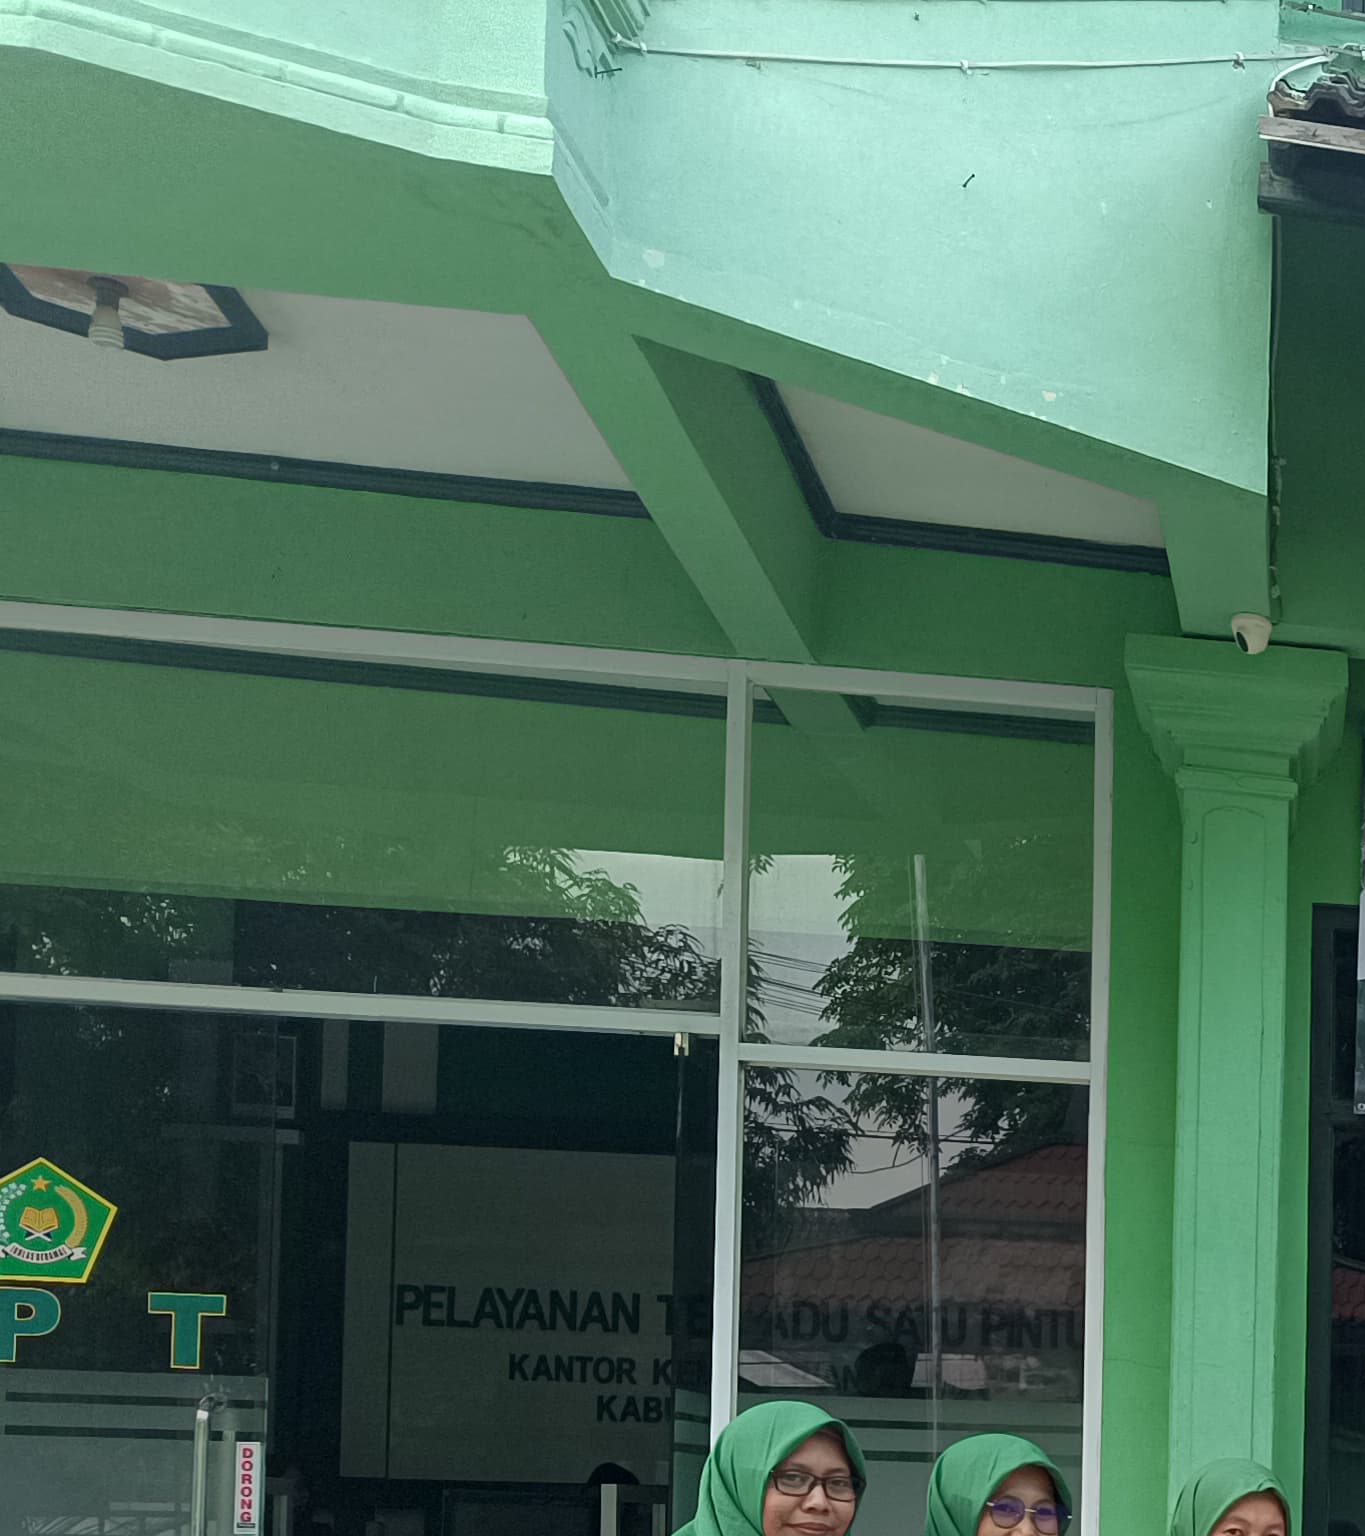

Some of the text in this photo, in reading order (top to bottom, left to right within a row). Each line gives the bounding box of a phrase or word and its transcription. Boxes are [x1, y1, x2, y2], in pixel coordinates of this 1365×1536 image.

[395, 1283, 641, 1335] PELAYANAN
[508, 1353, 637, 1386] KANTOR
[240, 1447, 254, 1522] DORONG
